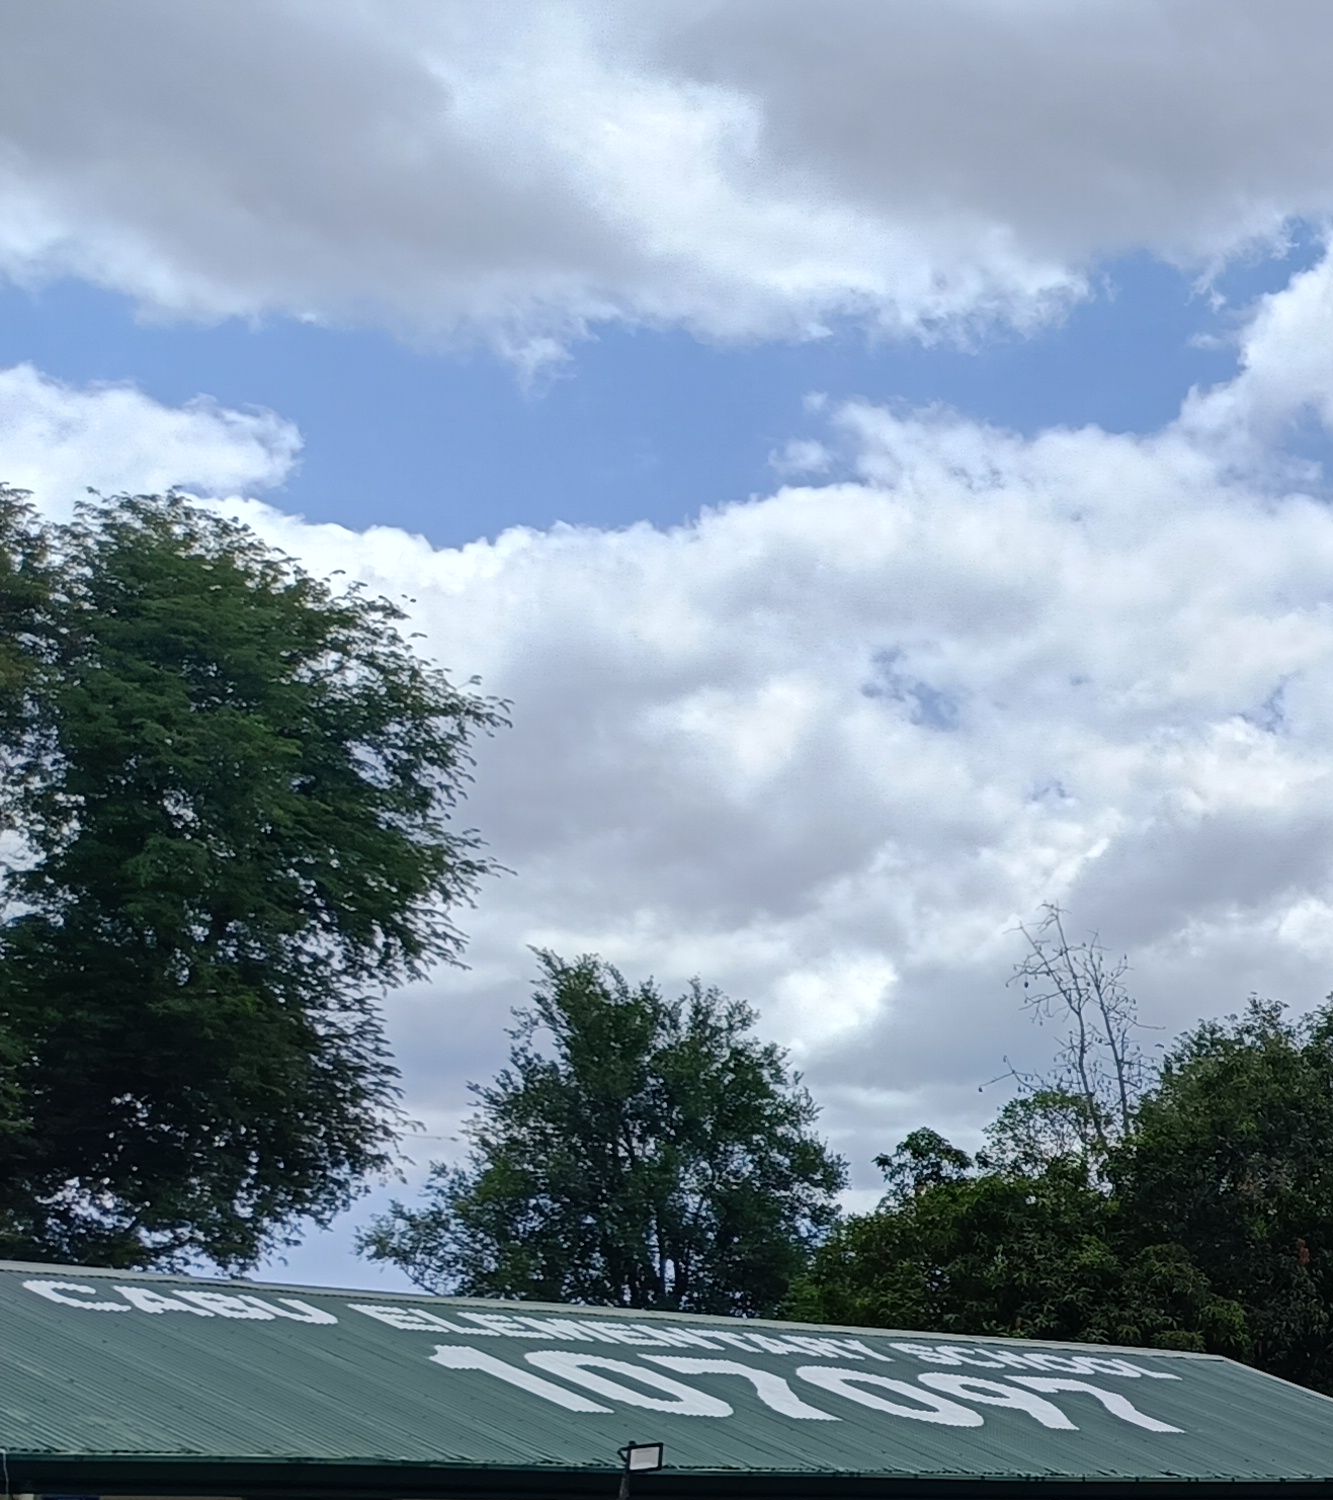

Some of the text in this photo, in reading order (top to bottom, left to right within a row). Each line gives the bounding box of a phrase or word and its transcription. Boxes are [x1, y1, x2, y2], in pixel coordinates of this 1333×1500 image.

[22, 1280, 1183, 1381] CABU ELEMENTARY SCHOOL
[428, 1344, 1186, 1434] 107097
